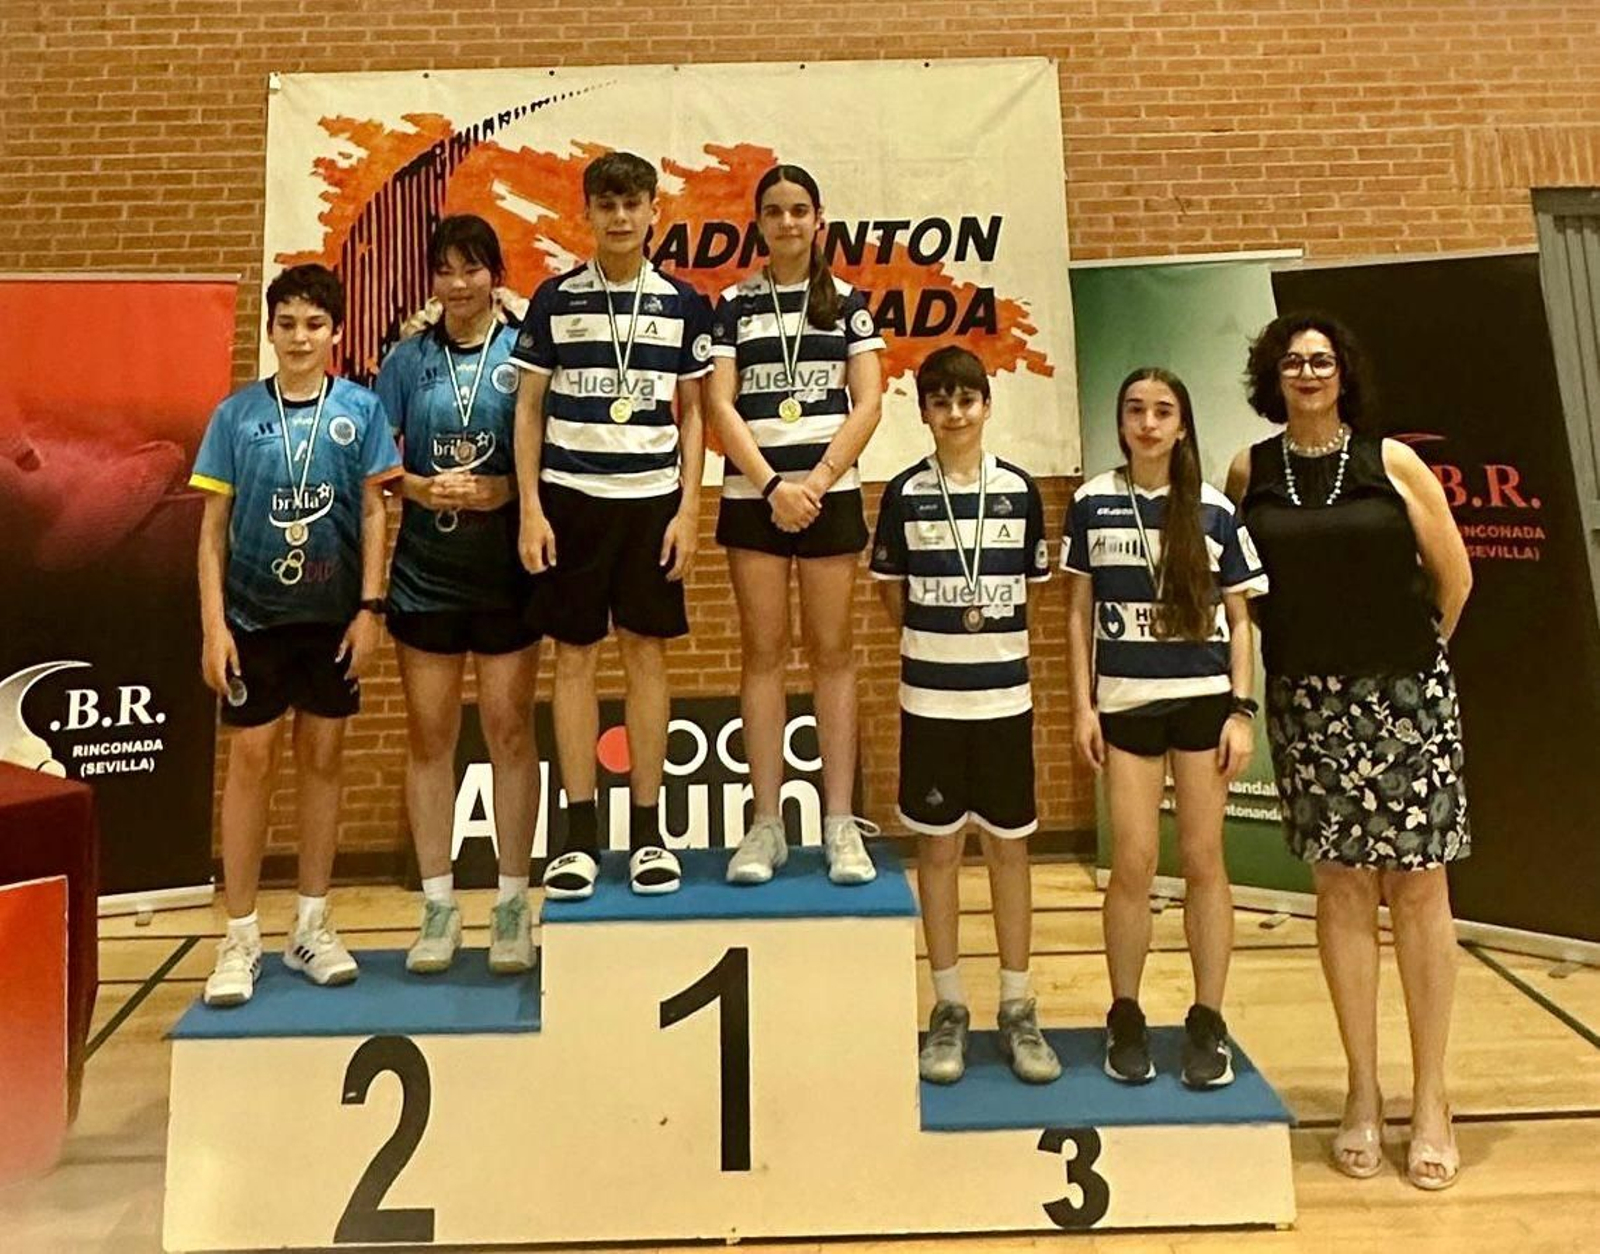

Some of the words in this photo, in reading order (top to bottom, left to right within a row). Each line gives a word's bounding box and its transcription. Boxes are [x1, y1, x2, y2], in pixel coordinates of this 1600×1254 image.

[72, 738, 164, 758] RINCONADA
[80, 757, 156, 778] (SEVILLA)
[660, 947, 751, 1172] 1
[334, 1034, 435, 1243] 2
[1037, 1126, 1110, 1229] 3
